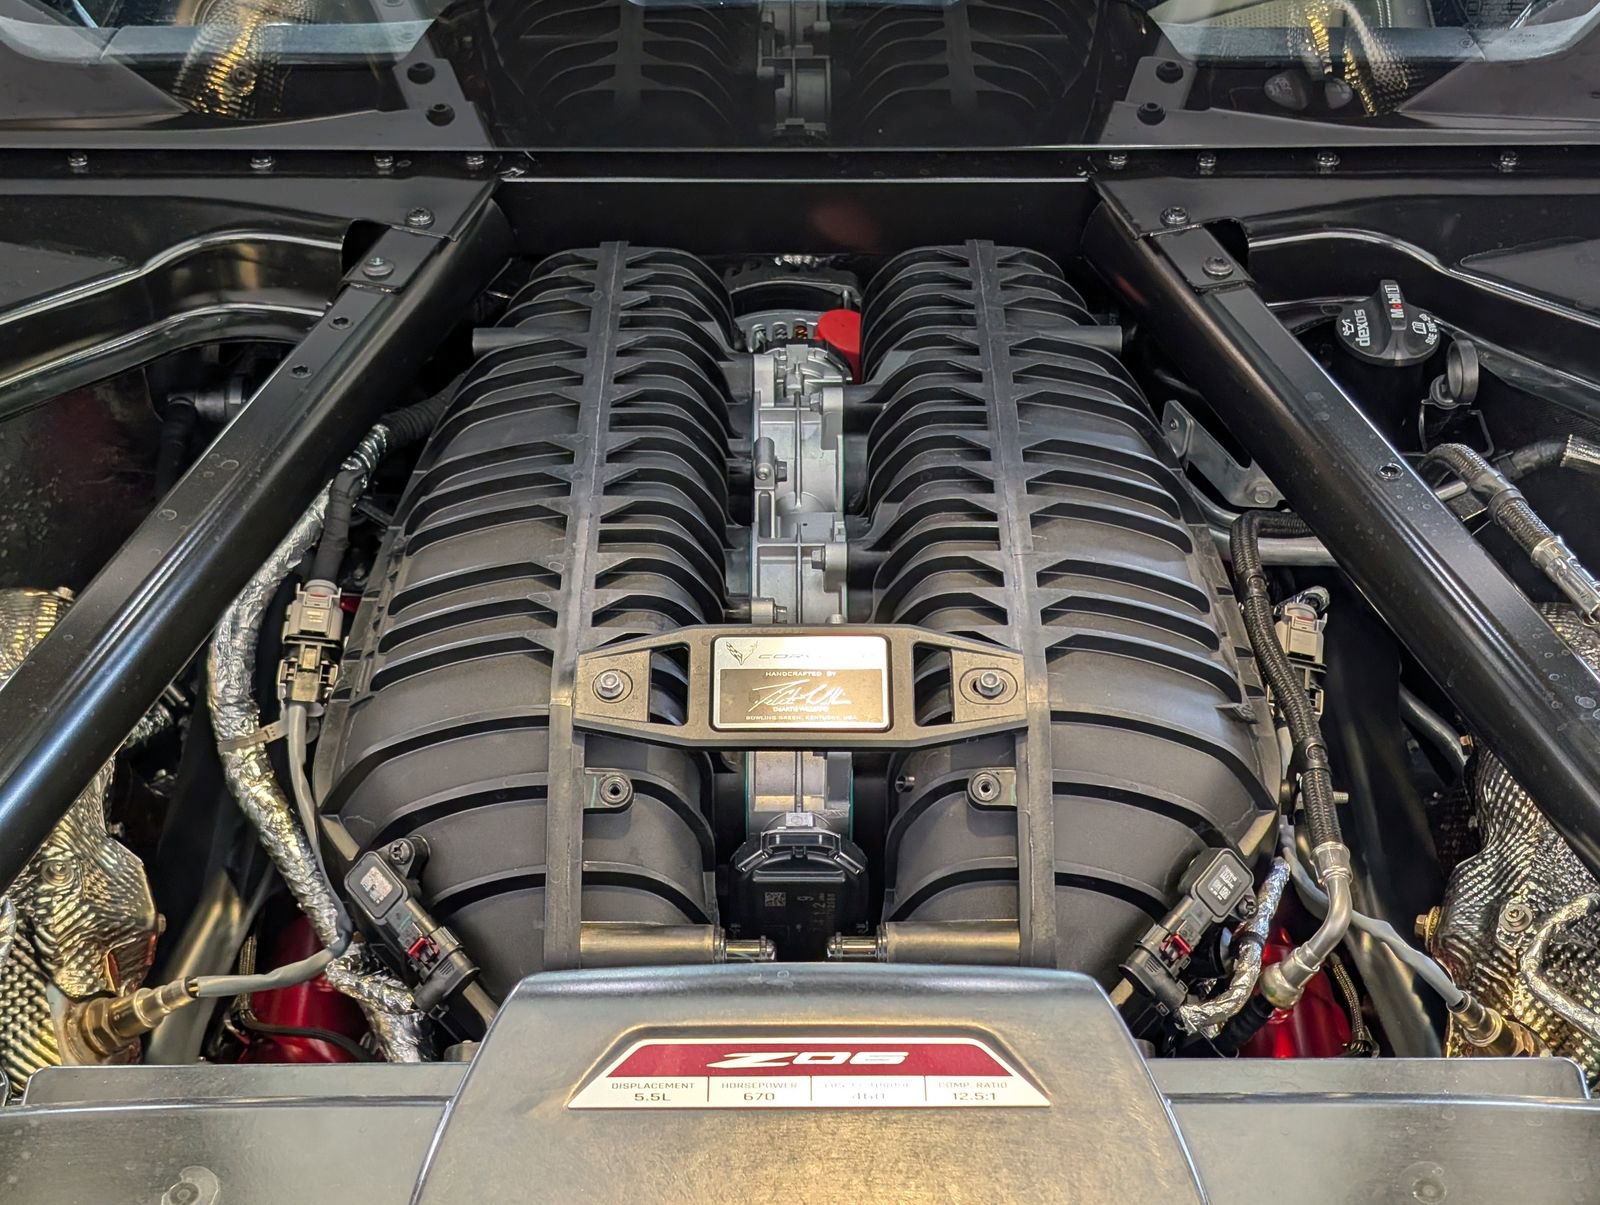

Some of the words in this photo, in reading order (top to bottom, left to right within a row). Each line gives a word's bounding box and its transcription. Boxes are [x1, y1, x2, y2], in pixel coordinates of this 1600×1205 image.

[1388, 293, 1404, 318] Mobil
[1354, 309, 1370, 346] dexos
[706, 1052, 910, 1068] Z06
[611, 1082, 695, 1090] DISPLACEMENT
[976, 1081, 1008, 1089] RATIO
[634, 1092, 671, 1101] 5.5L
[743, 1092, 775, 1101] 670
[952, 1092, 997, 1101] 12.5:1
